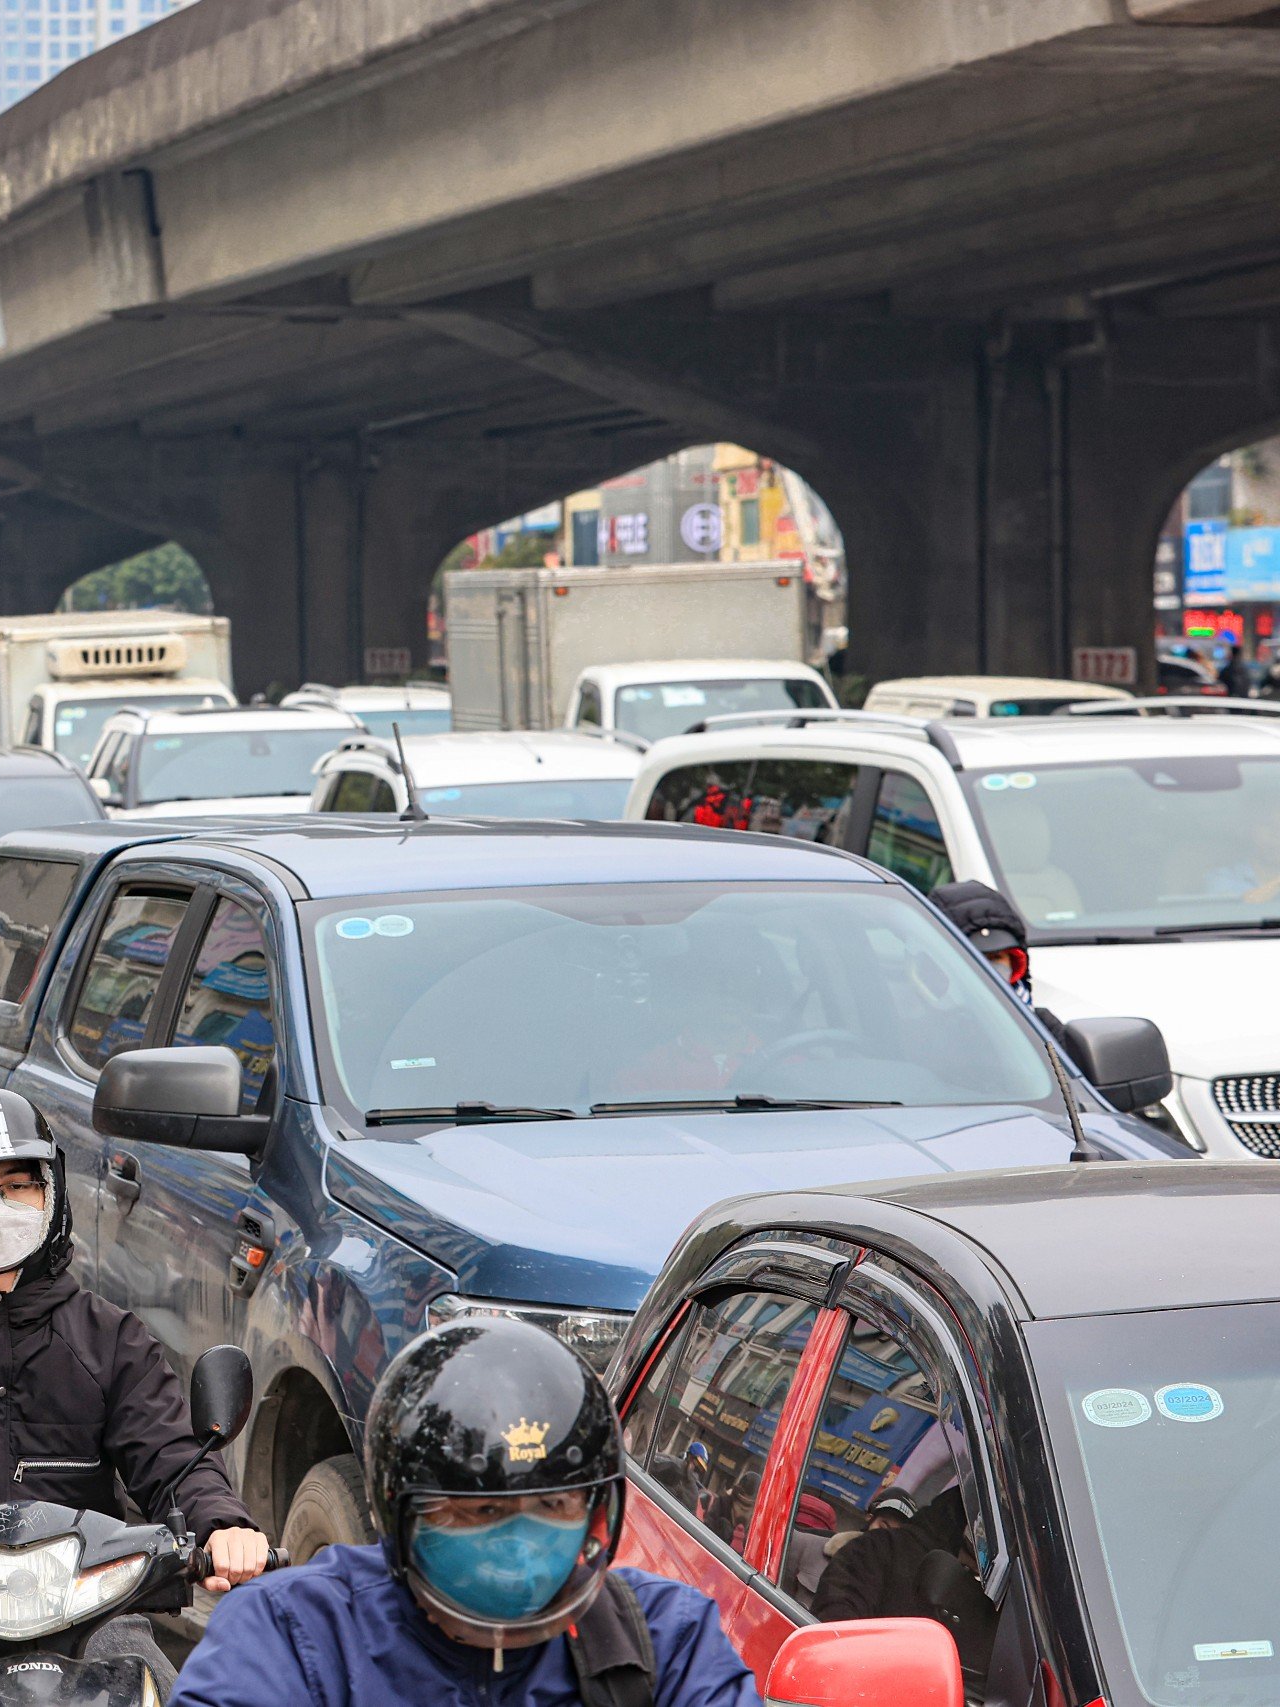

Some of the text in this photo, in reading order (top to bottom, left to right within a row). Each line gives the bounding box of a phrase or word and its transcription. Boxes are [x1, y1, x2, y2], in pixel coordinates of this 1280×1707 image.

[1167, 1394, 1212, 1404] 03/2024
[1096, 1400, 1134, 1411] 03/2024
[508, 1443, 548, 1463] Royal
[6, 1661, 64, 1675] HONDA
